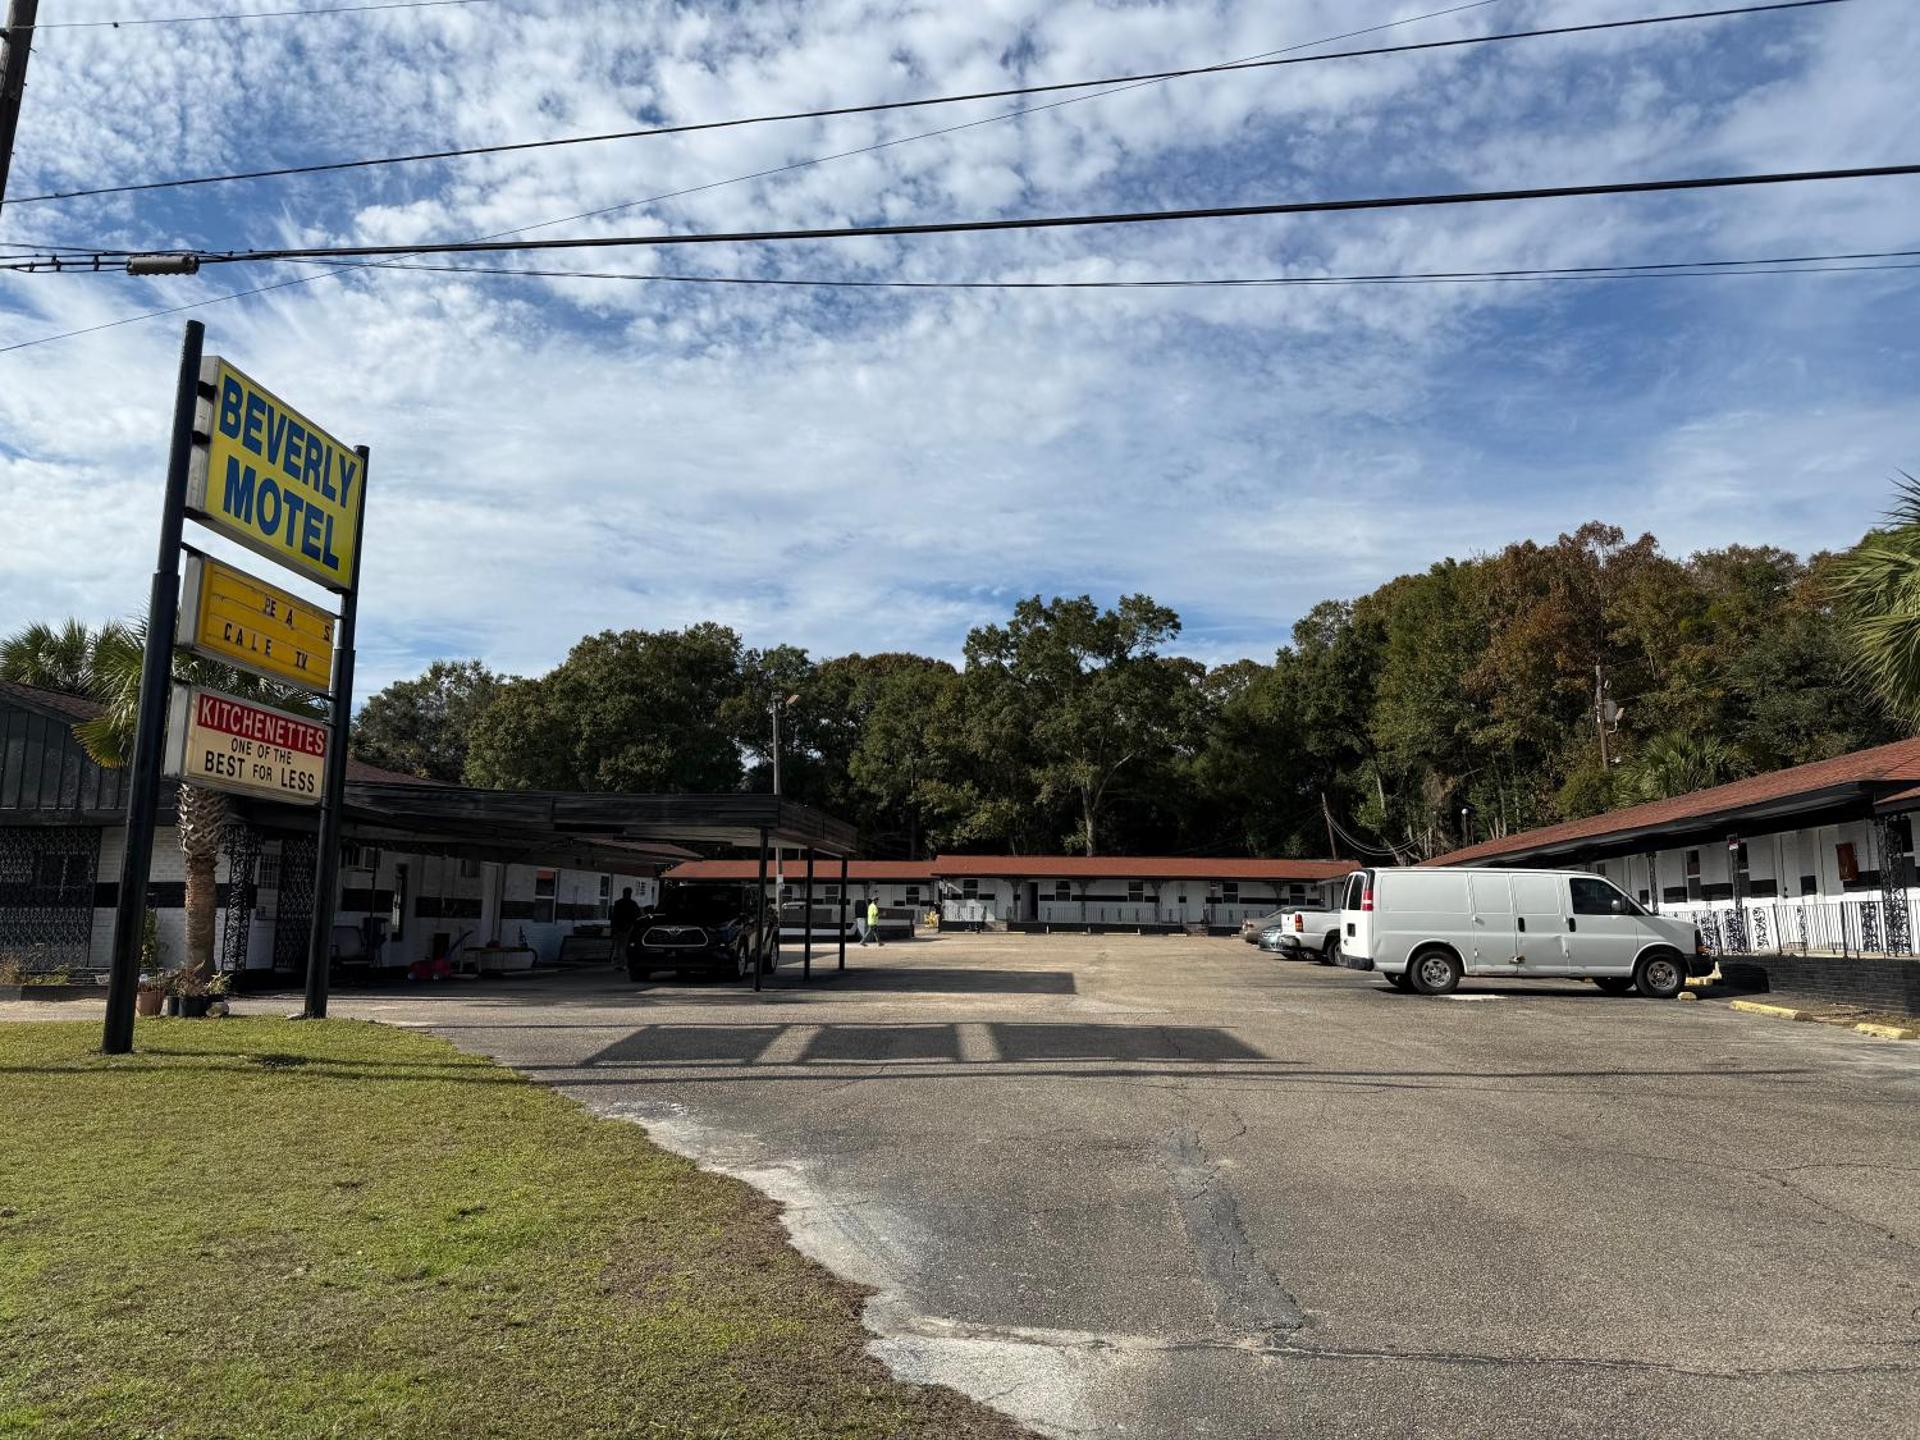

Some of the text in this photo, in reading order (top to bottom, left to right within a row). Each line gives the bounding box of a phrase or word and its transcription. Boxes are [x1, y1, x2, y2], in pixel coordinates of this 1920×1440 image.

[219, 374, 355, 508] BEVERLY
[223, 454, 340, 571] MOTEL
[296, 651, 308, 671] TV
[201, 698, 325, 754] KITCHENETTES
[204, 750, 314, 793] BEST FOR LESS
[231, 737, 292, 765] ONE OF THE
